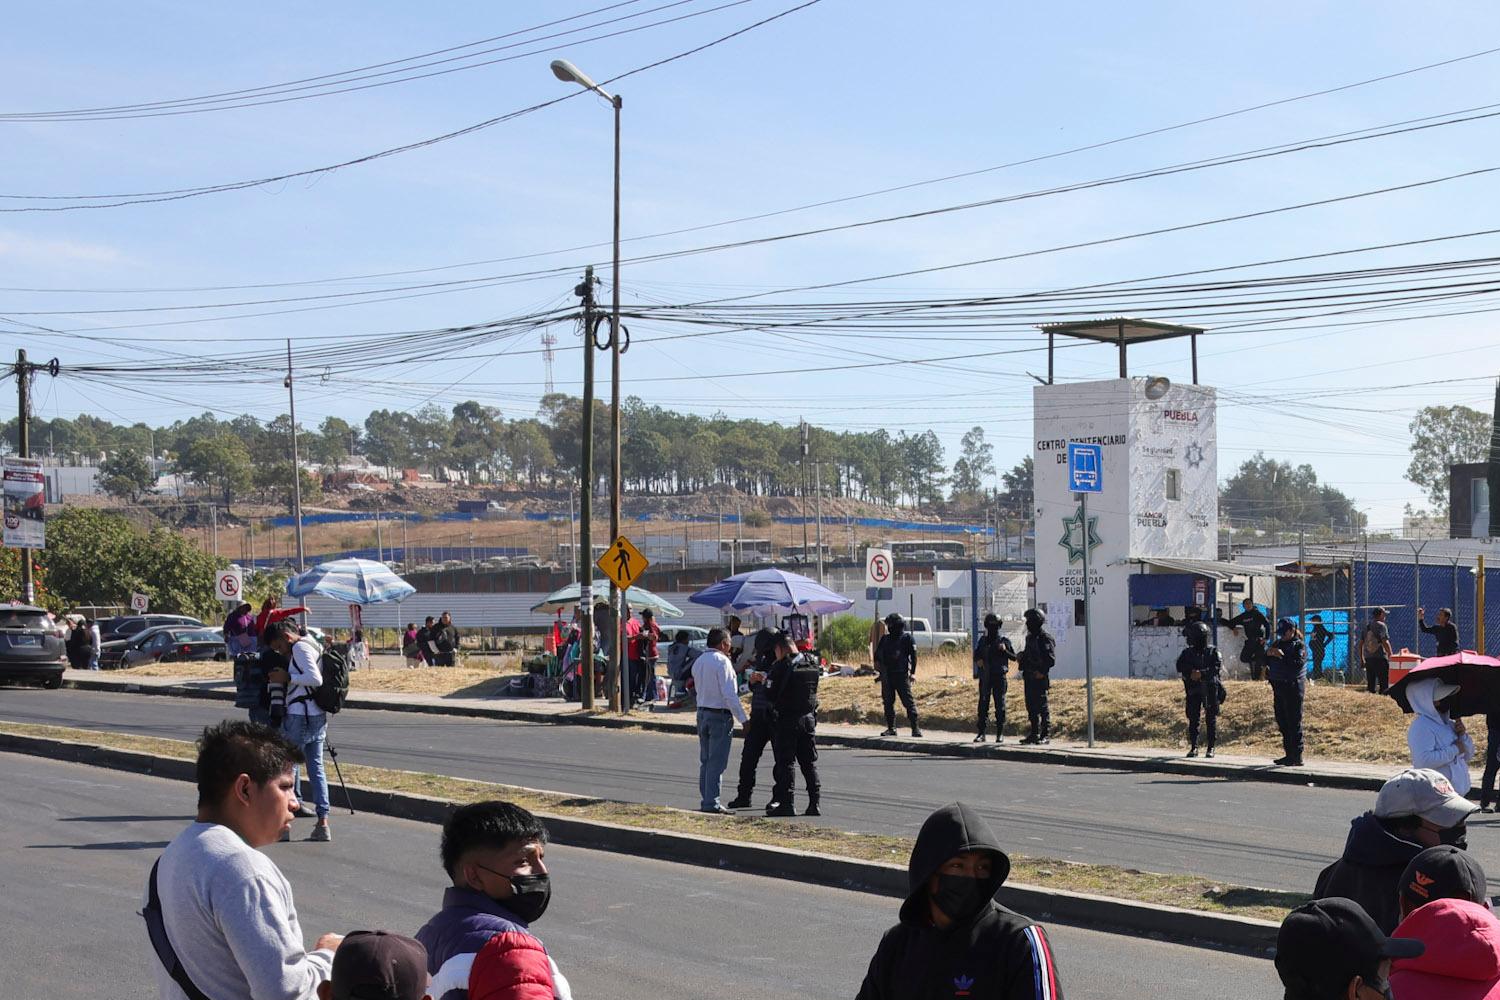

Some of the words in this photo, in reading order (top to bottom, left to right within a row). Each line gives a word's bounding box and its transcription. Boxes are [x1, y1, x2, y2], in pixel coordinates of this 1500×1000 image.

[1164, 410, 1198, 421] PUEBLA
[1037, 440, 1066, 451] CENTRO
[1056, 453, 1067, 464] DE
[1137, 518, 1167, 528] PUEBLA
[1059, 577, 1104, 586] SEGURDAD
